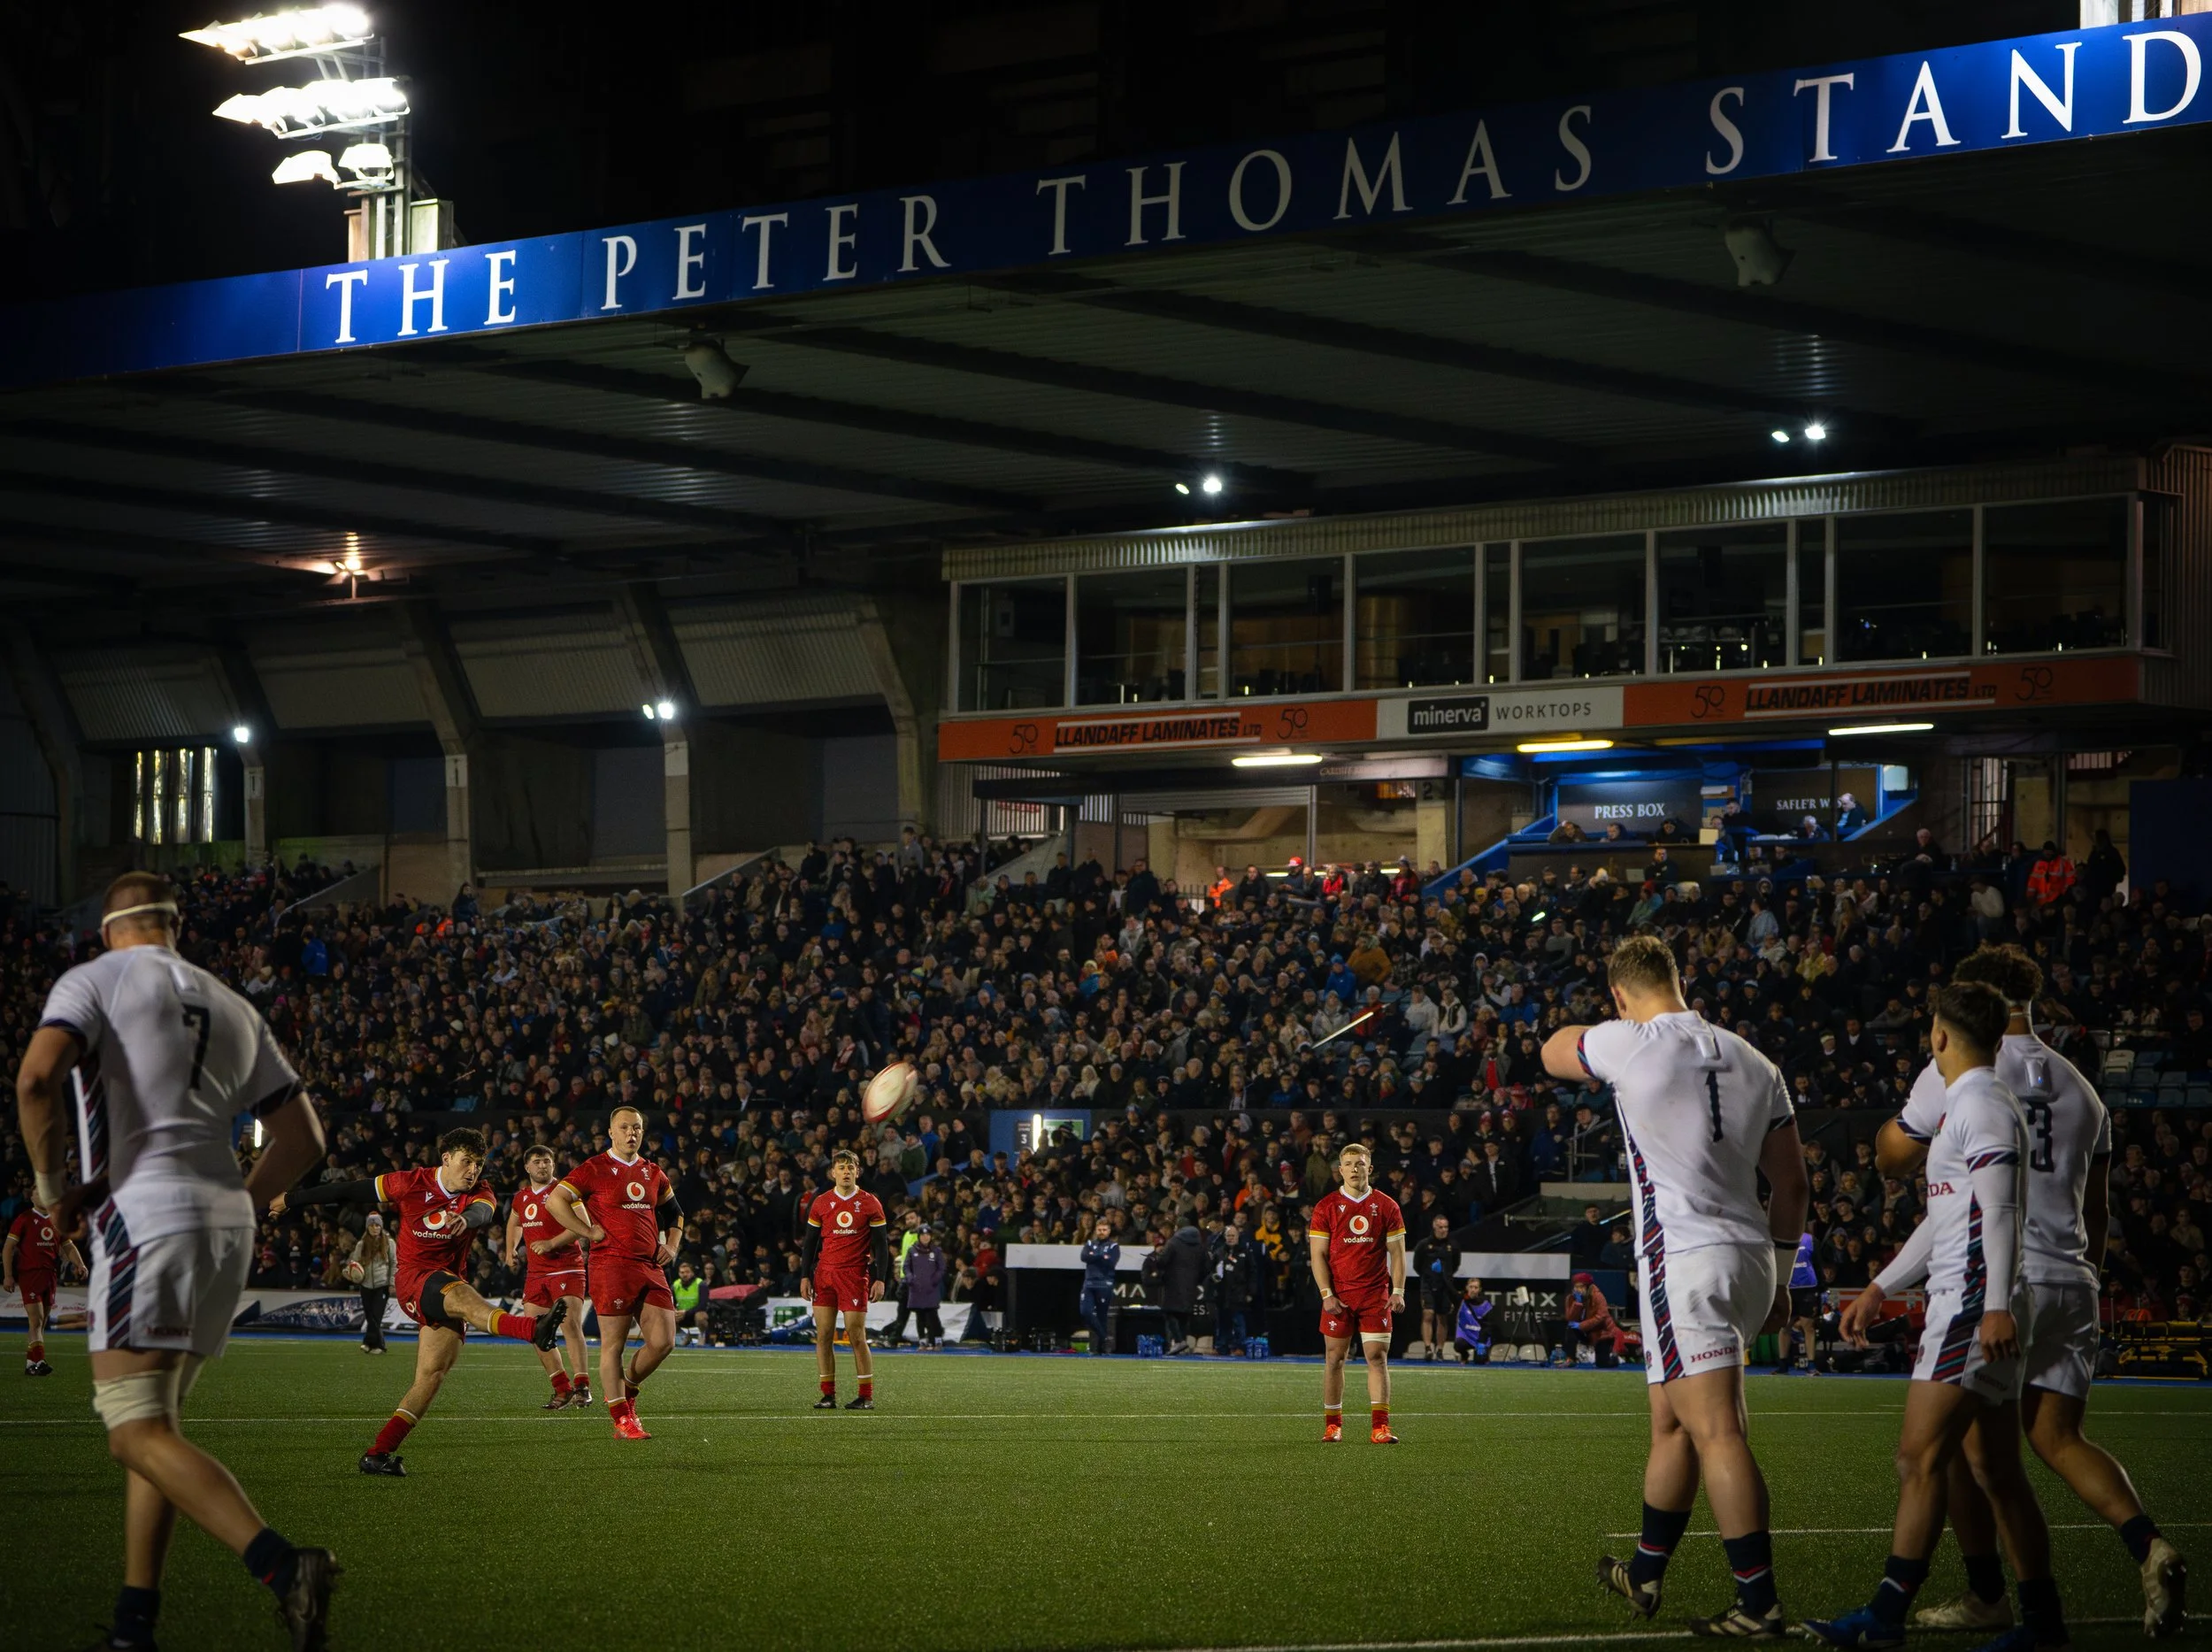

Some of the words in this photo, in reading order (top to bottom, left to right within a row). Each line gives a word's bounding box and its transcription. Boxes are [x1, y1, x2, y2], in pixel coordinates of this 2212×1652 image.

[326, 250, 517, 343] THE
[600, 195, 952, 311] PETER
[1034, 104, 1592, 256] THOMAS
[1705, 29, 2204, 175] STAND
[1744, 684, 1847, 711] LLANDAFF
[1849, 677, 1970, 704] LAMINATES
[1974, 684, 1998, 698] LTD
[2015, 666, 2054, 702] 50
[1413, 701, 1482, 726] minerva
[1495, 702, 1592, 721] WORKTOPS
[1690, 685, 1725, 719] 50
[1009, 723, 1039, 755] 50
[1054, 723, 1141, 747] LLANDAFF
[1141, 718, 1240, 742] LAMINATES
[1242, 724, 1263, 737] LTD
[1277, 708, 1309, 741] 50
[1594, 803, 1634, 819] PRESS
[1637, 802, 1666, 818] BOX
[1776, 797, 1816, 811] SAFLE'R
[181, 1002, 211, 1092] 7
[1704, 1070, 1724, 1143] 1
[1020, 1133, 1028, 1145] 3
[2025, 1100, 2055, 1173] 3
[412, 1229, 452, 1240] vodafone
[1343, 1235, 1374, 1244] vodafone
